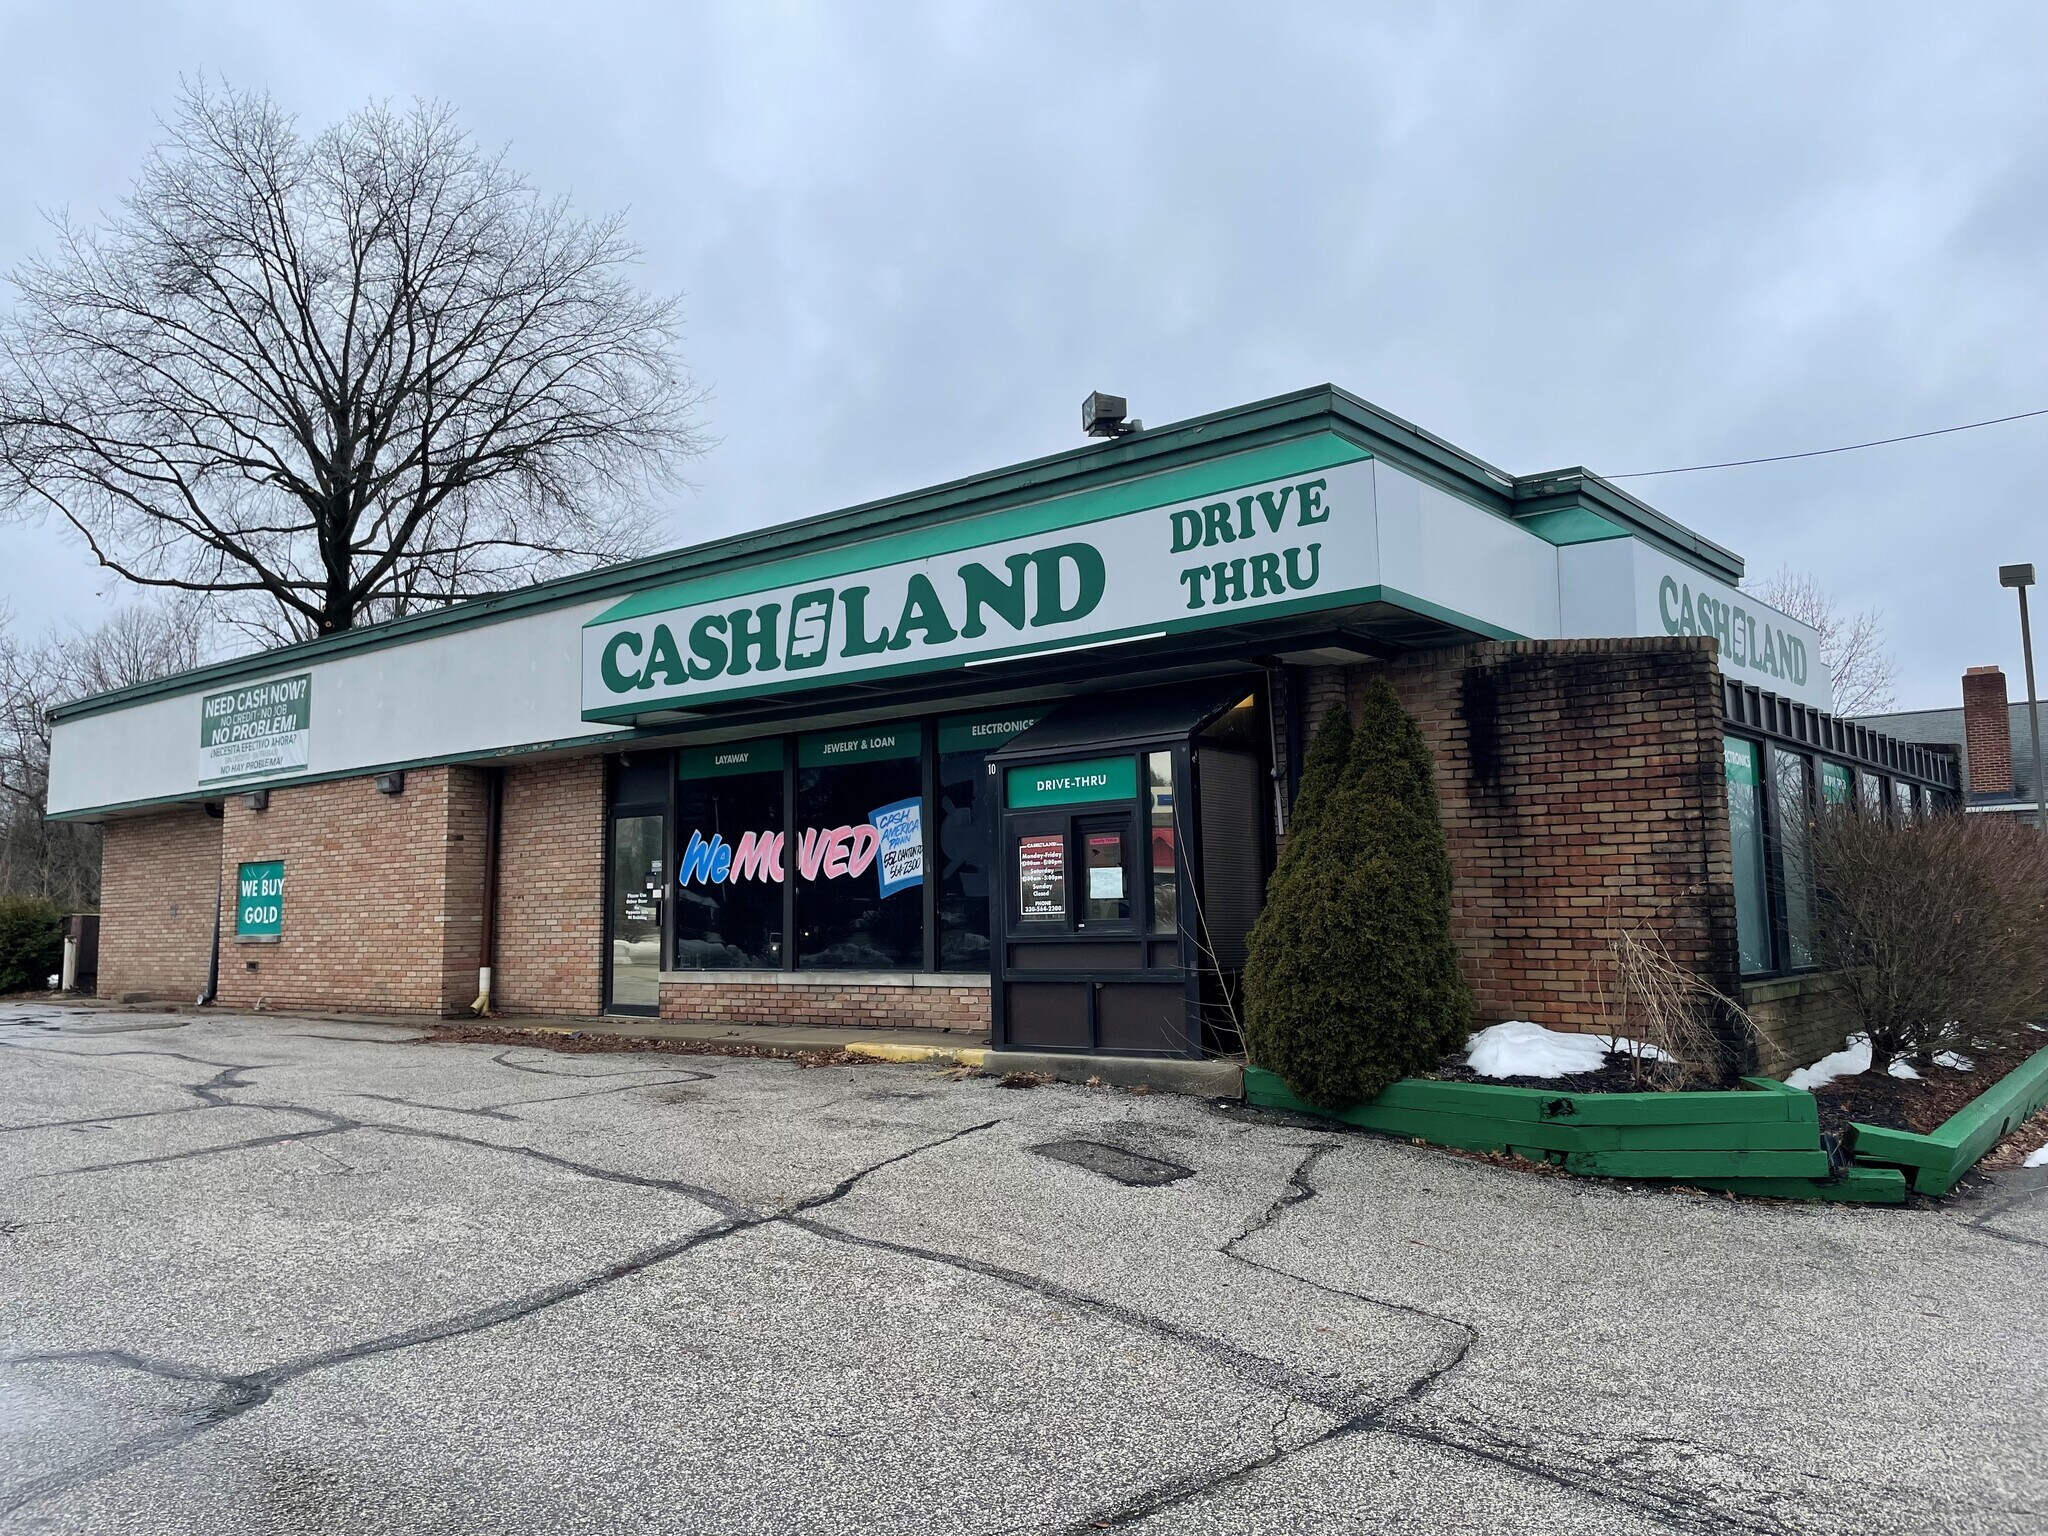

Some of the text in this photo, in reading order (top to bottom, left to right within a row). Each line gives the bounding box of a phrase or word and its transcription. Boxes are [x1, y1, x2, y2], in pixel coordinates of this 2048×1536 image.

[1169, 478, 1330, 554] DRIVE
[1180, 543, 1322, 610] THRU
[205, 679, 307, 718] NEED CASH NOW?
[220, 704, 287, 727] NO CREDIT NO JOB
[211, 714, 297, 746] NO PROBLEM!
[241, 738, 270, 753] EFECTIVO
[271, 734, 297, 748] AHORA?
[822, 736, 895, 754] JEWELRY & LOAN
[220, 756, 284, 775] NO HAY PROBLEMA!
[714, 752, 749, 765] LAYAWAY
[987, 763, 996, 775] 10
[1036, 774, 1107, 792] DRIVE-THRU
[880, 809, 911, 829] CASH
[881, 819, 920, 843] AMERICA
[679, 829, 732, 887] We
[241, 878, 285, 897] WE BUY
[244, 906, 278, 924] GOLD
